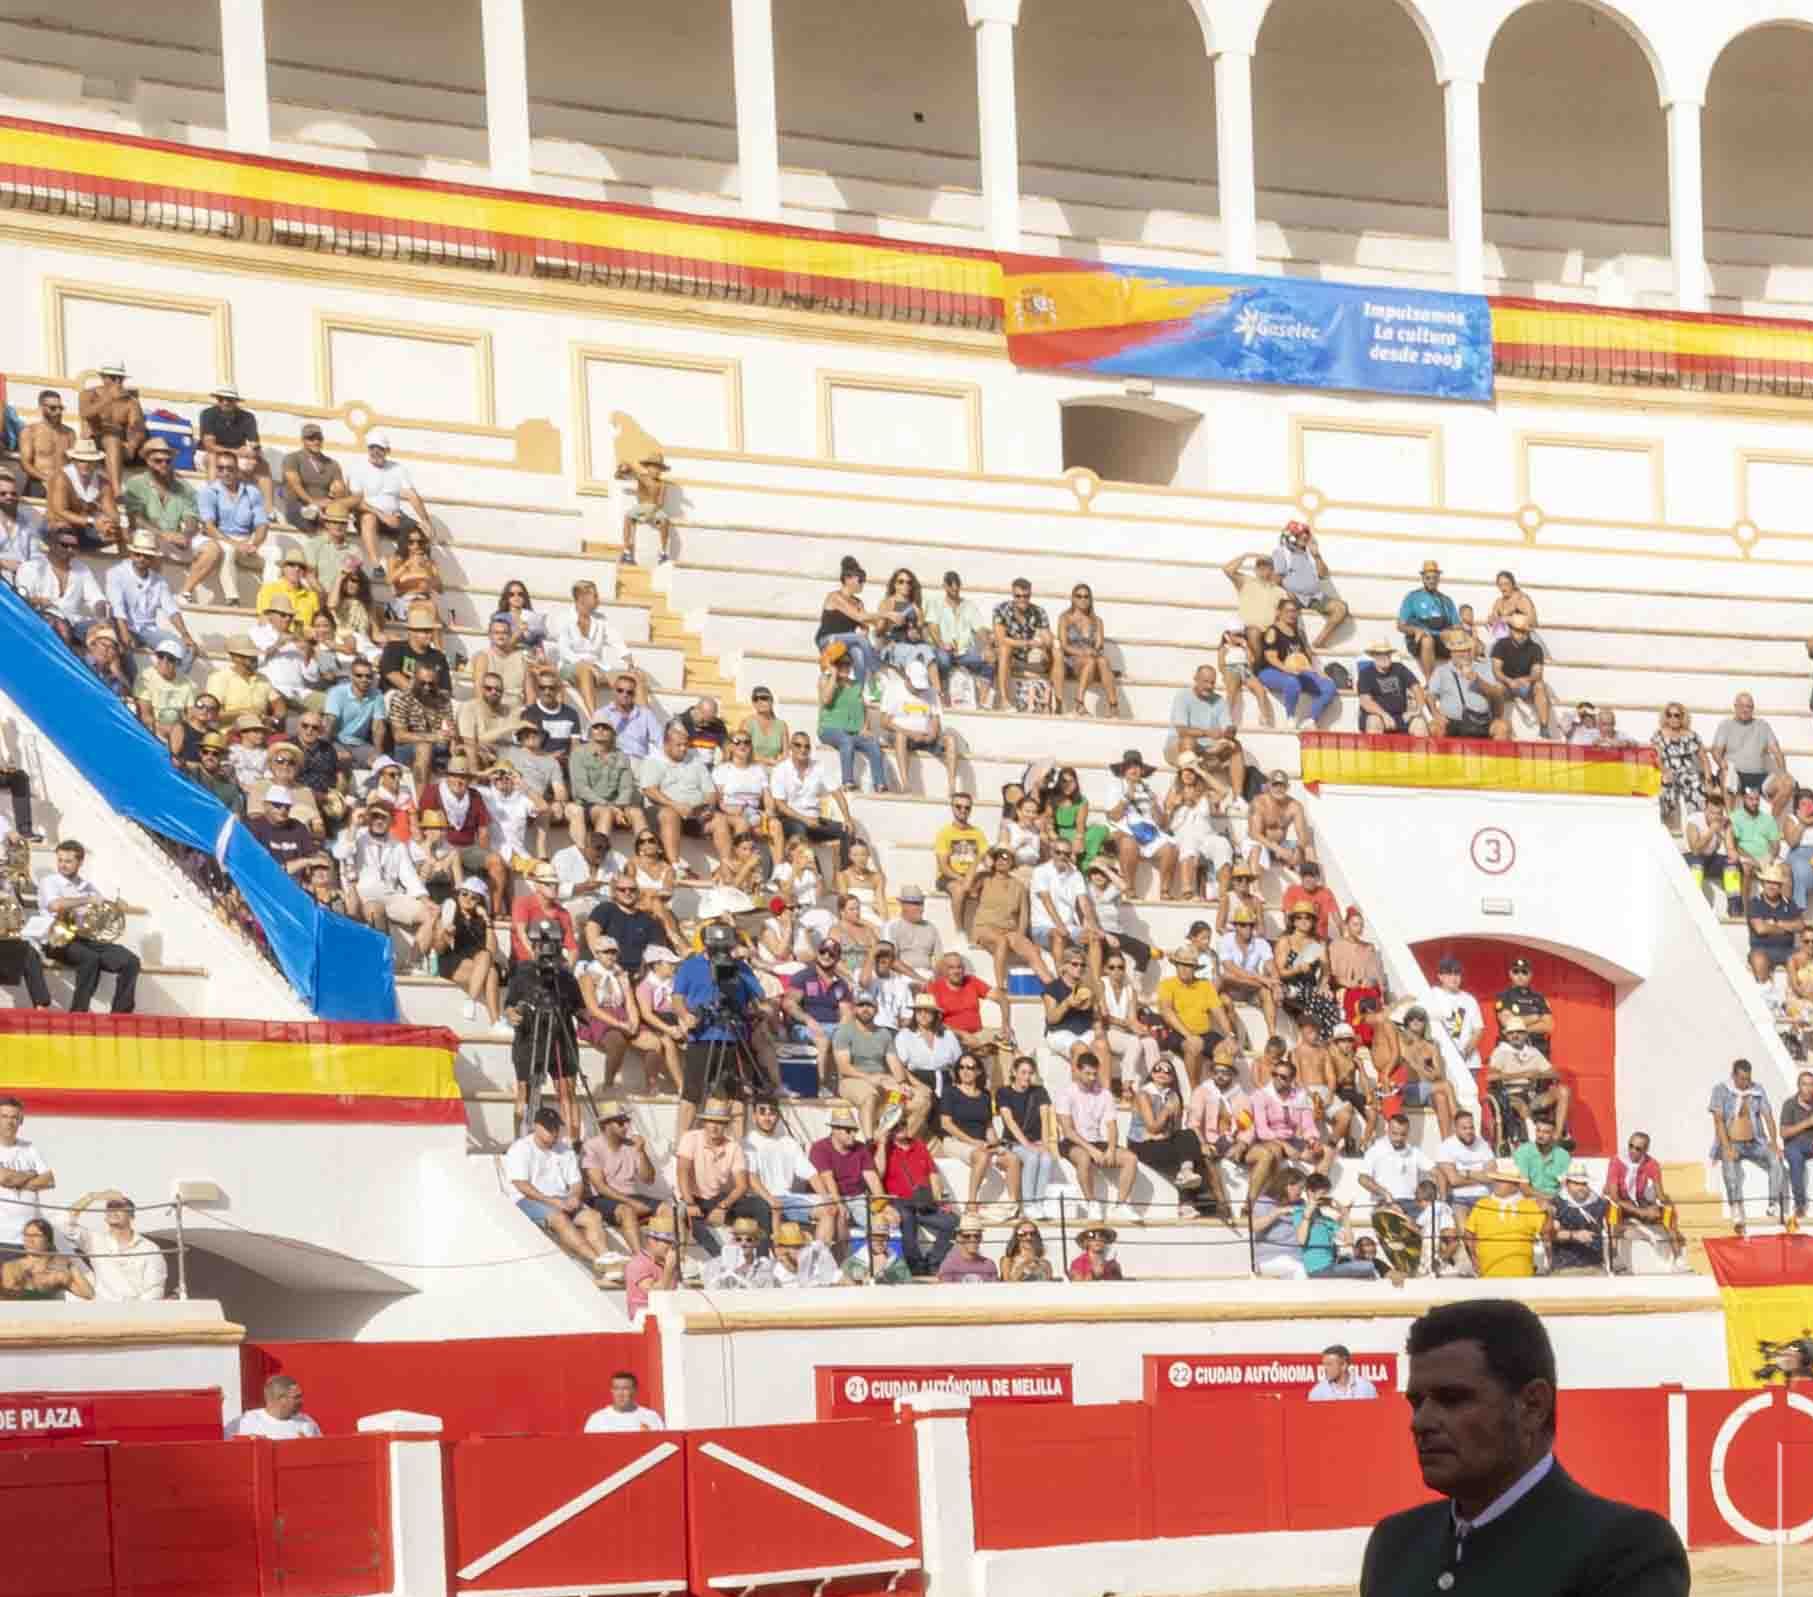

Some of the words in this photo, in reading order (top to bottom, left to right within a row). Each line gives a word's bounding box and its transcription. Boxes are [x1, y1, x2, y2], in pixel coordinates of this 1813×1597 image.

[1363, 301, 1465, 326] Impulsamos
[1398, 326, 1457, 345] cultura
[1369, 344, 1418, 364] desde
[1422, 350, 1464, 370] 2003
[1485, 838, 1501, 864] 3
[1195, 1366, 1242, 1385] CIUDAD
[1244, 1361, 1315, 1383] AUTÓNOMA
[871, 1380, 917, 1398] CIUDAD
[920, 1376, 990, 1397] AUTÓNOMA
[992, 1379, 1009, 1396] DE
[1011, 1377, 1063, 1396] MELILLA
[21, 1407, 83, 1429] PLAZA
